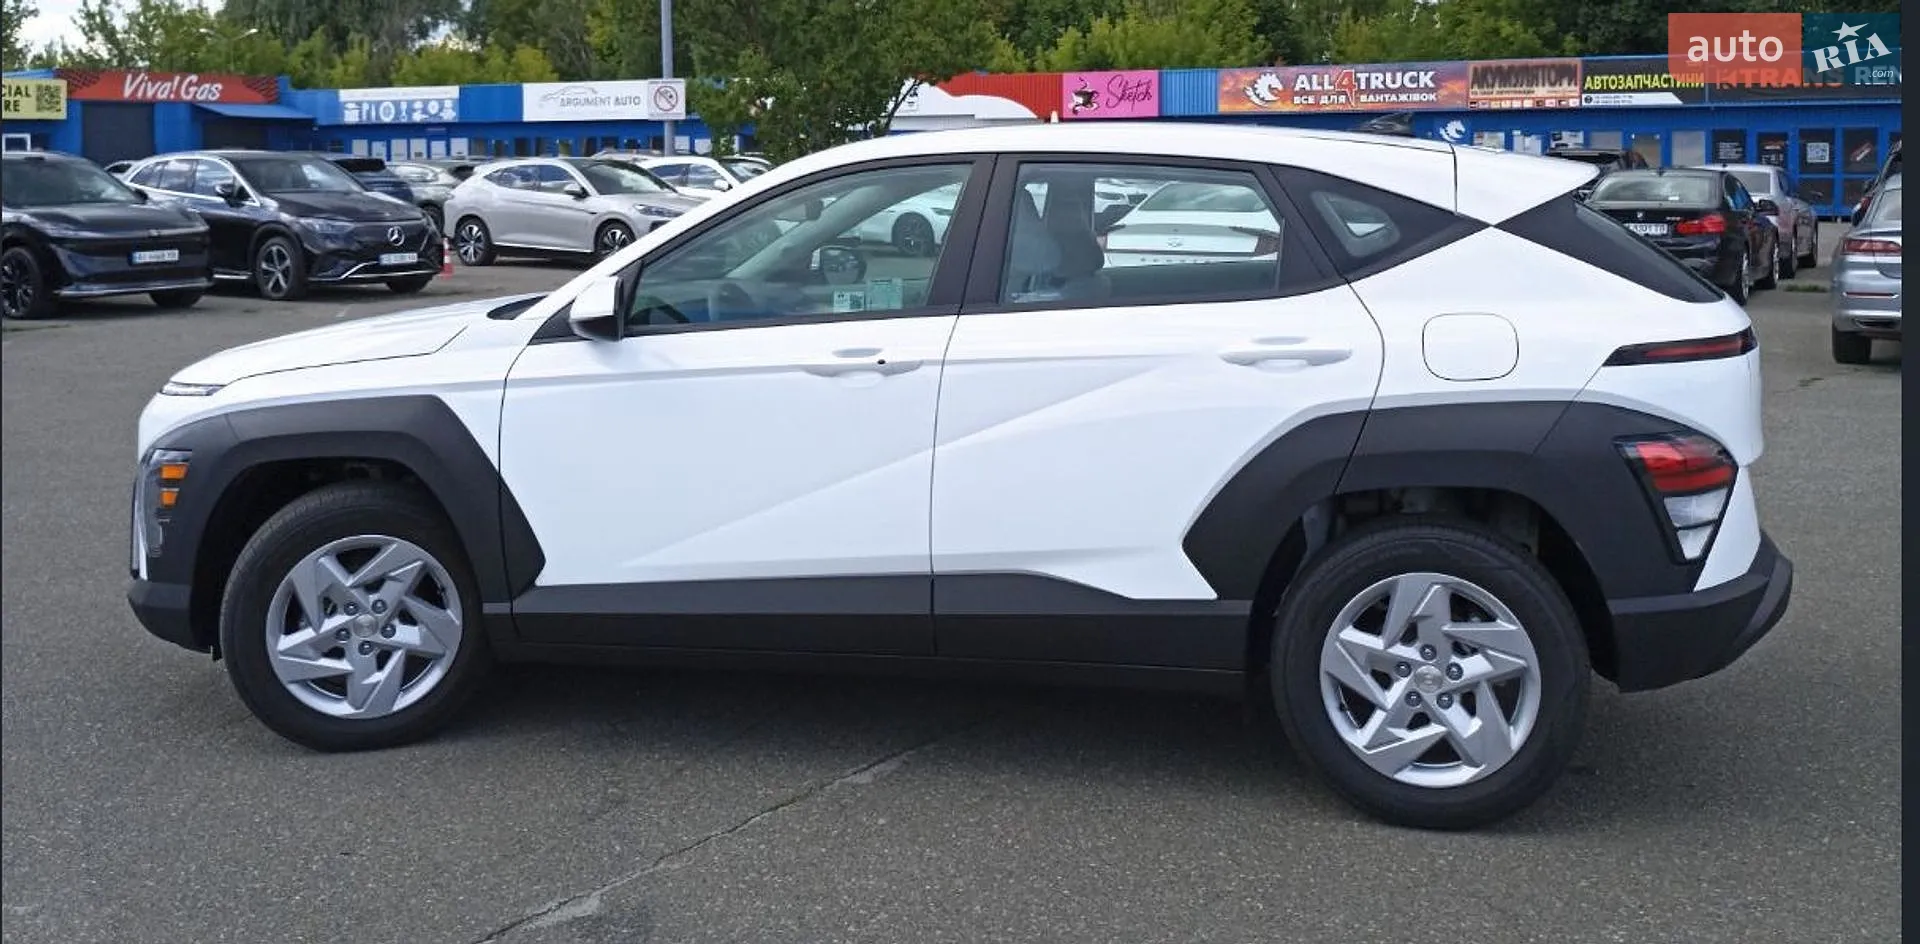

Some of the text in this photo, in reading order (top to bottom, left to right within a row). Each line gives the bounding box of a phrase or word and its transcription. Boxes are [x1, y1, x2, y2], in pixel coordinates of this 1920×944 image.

[123, 72, 223, 100] Viva! Gas
[1584, 73, 1705, 90] АВТОЗАПЧАСТИНИ
[1105, 73, 1153, 112] Sketch
[1293, 91, 1437, 105] ВСЕ ДЛЯ ВАНТАЖІВОК
[559, 95, 641, 108] ARGUMENT AUTO
